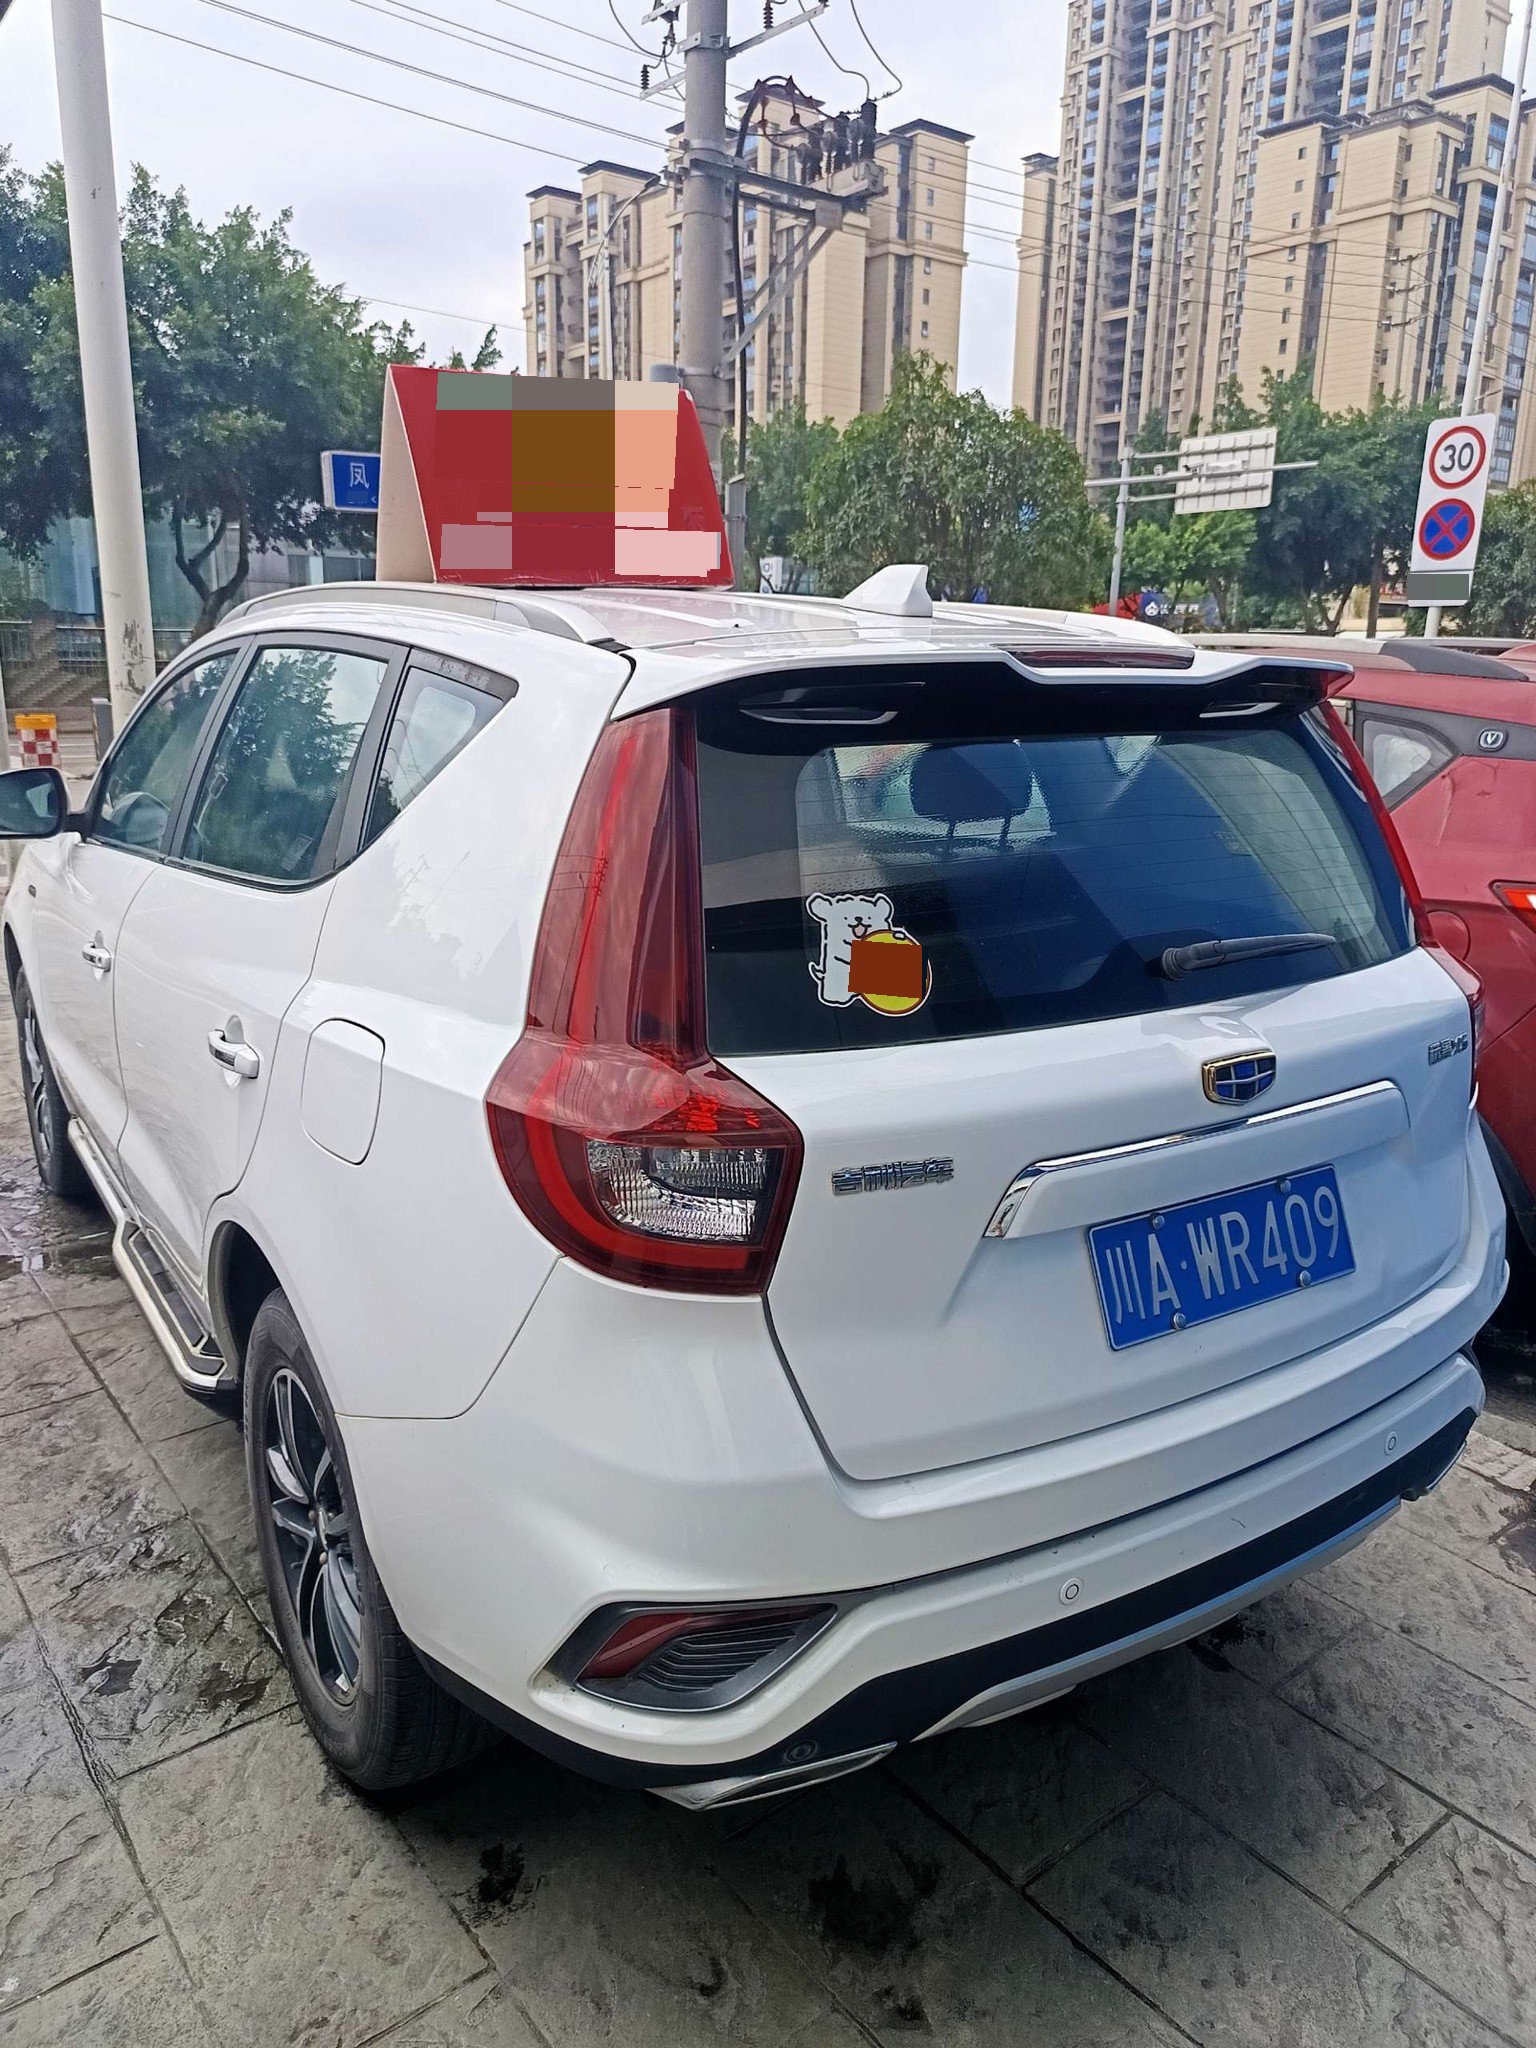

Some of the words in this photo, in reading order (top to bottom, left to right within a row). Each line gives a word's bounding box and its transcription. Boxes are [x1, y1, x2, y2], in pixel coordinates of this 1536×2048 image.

[1440, 442, 1474, 473] 30
[831, 1156, 955, 1197] 吉利汽车
